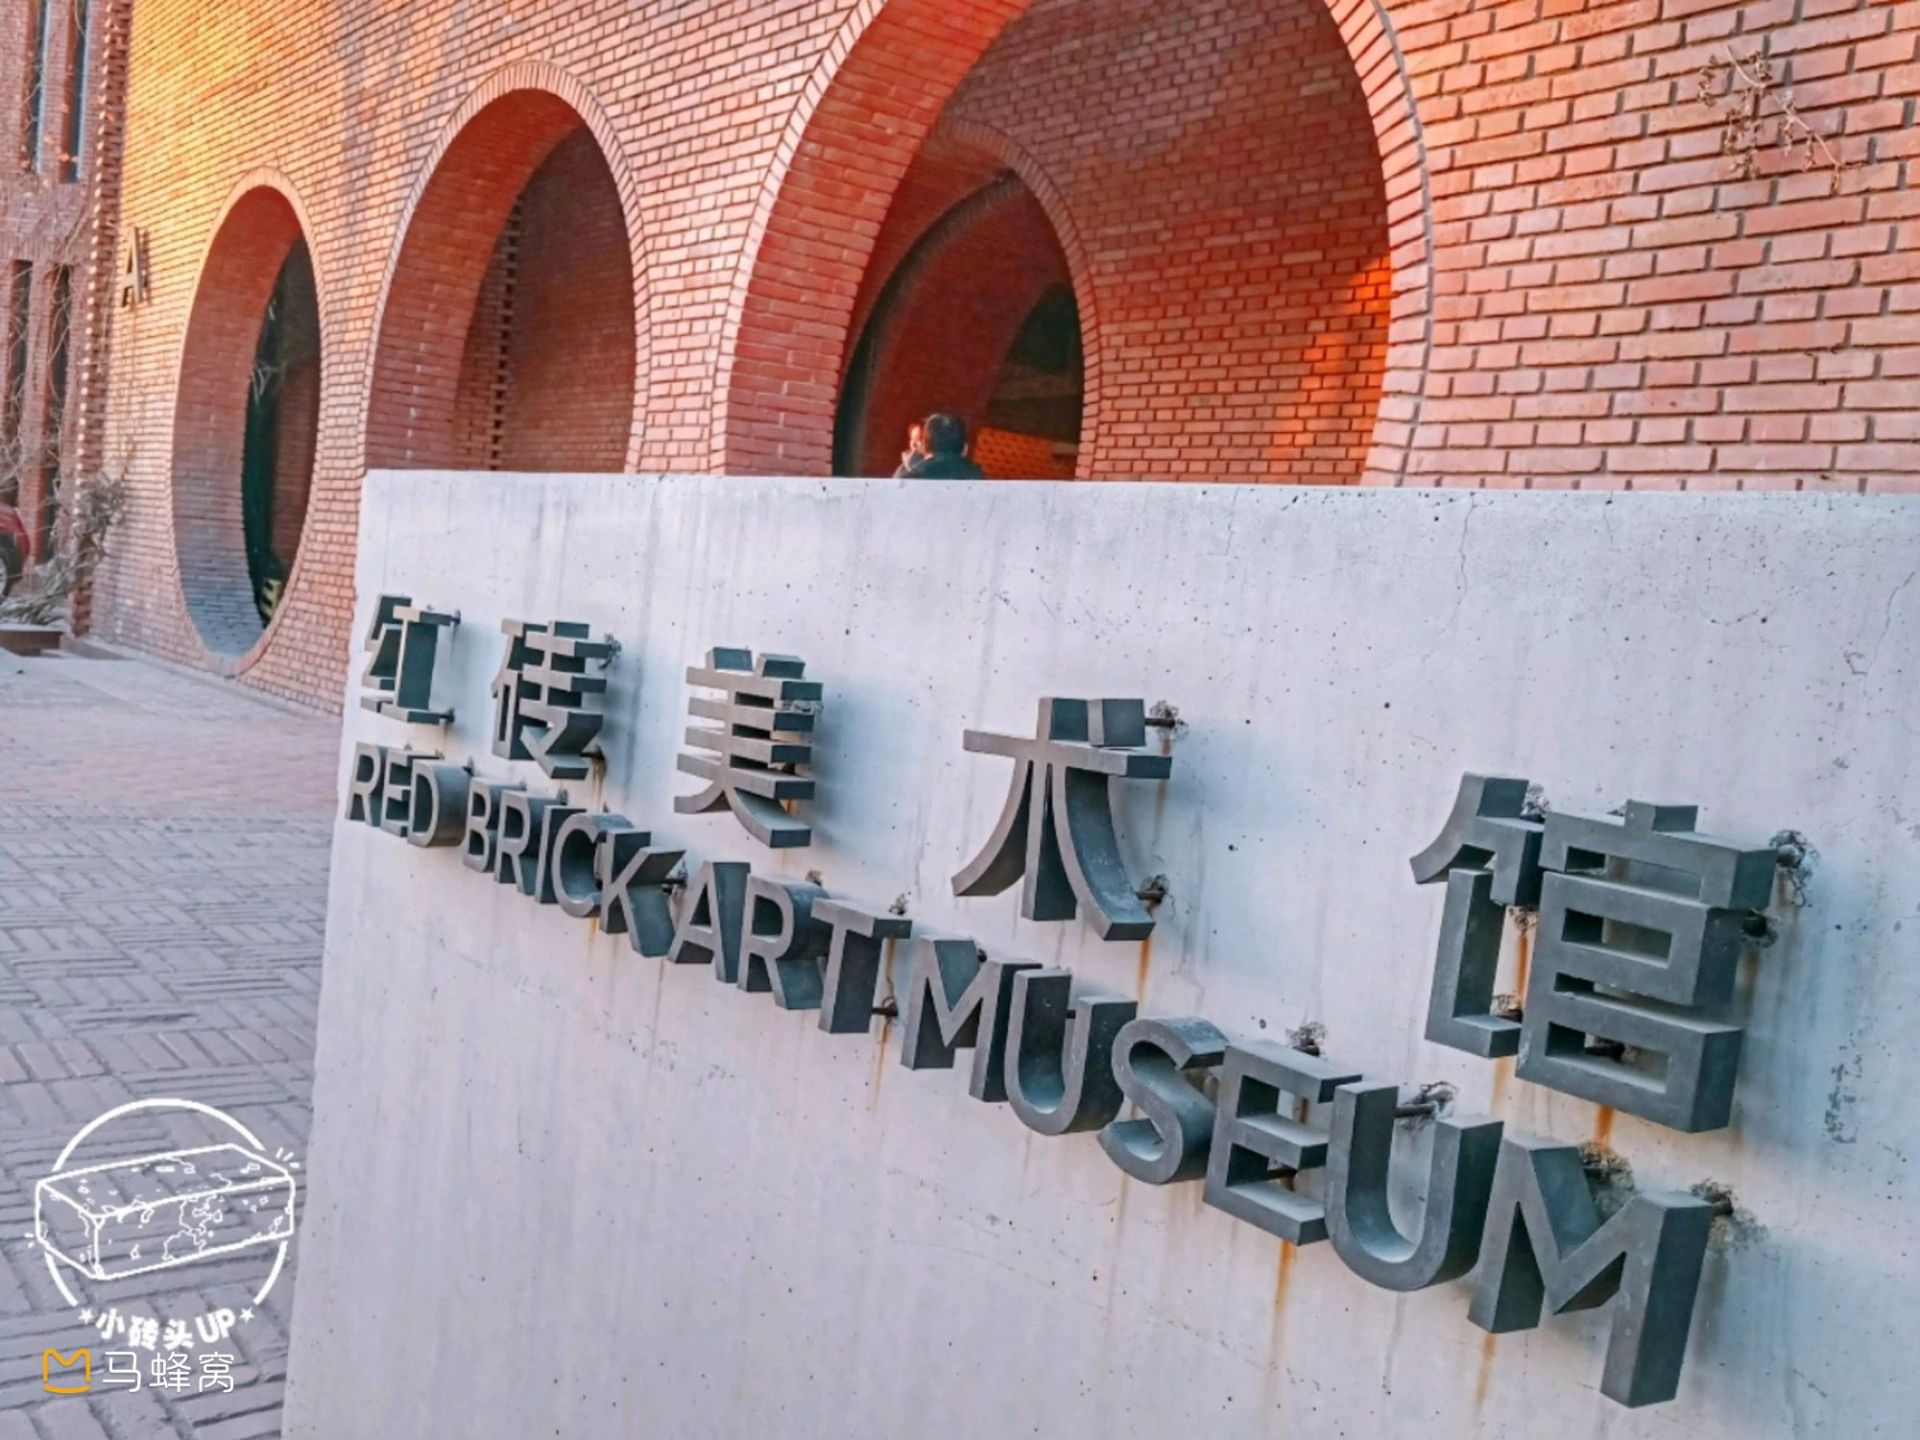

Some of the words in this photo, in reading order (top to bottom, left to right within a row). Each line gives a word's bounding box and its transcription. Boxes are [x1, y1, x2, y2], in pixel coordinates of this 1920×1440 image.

[120, 227, 145, 308] A
[345, 741, 472, 848] RED
[462, 776, 687, 958] BRICK
[668, 861, 912, 1034] ART
[900, 936, 1716, 1409] MUSEUM
